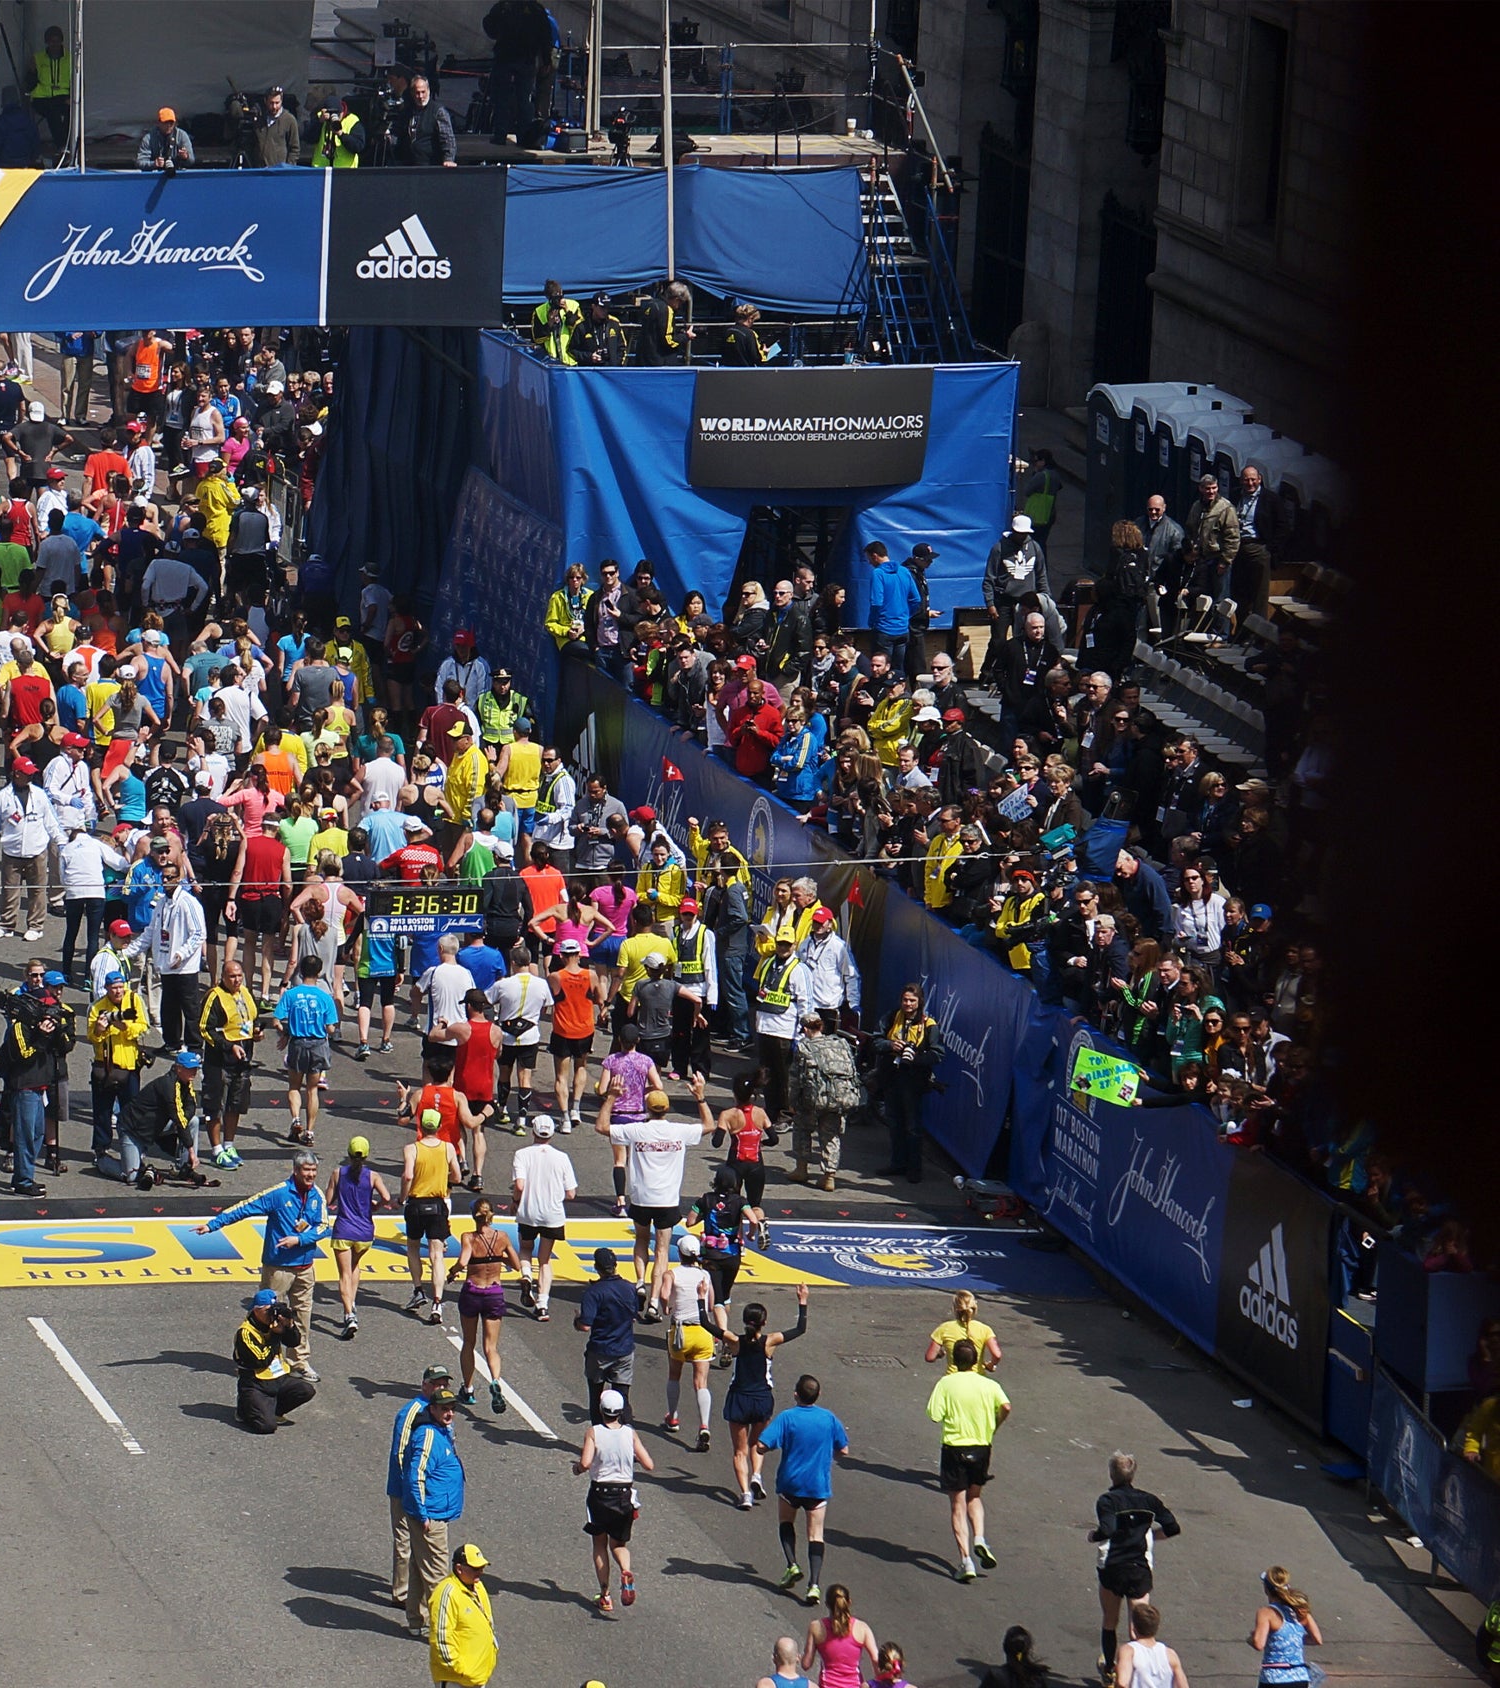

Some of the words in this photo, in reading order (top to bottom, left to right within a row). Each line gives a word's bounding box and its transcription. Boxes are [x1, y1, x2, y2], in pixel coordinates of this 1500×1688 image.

[24, 222, 119, 302] John
[356, 254, 452, 280] adidas
[699, 432, 730, 442] TOKYO
[731, 432, 768, 442] BOSTON
[769, 432, 806, 442] LONDON
[806, 432, 838, 442] BERLIN
[838, 431, 878, 441] CHICAGO
[878, 431, 899, 440] NEW
[899, 430, 923, 439] YORK
[390, 894, 478, 915] 3:36:30
[1054, 1126, 1099, 1181] MARATHON
[1071, 1113, 1100, 1155] BOSTON
[1107, 1127, 1153, 1227] John
[1238, 1284, 1299, 1351] adidas
